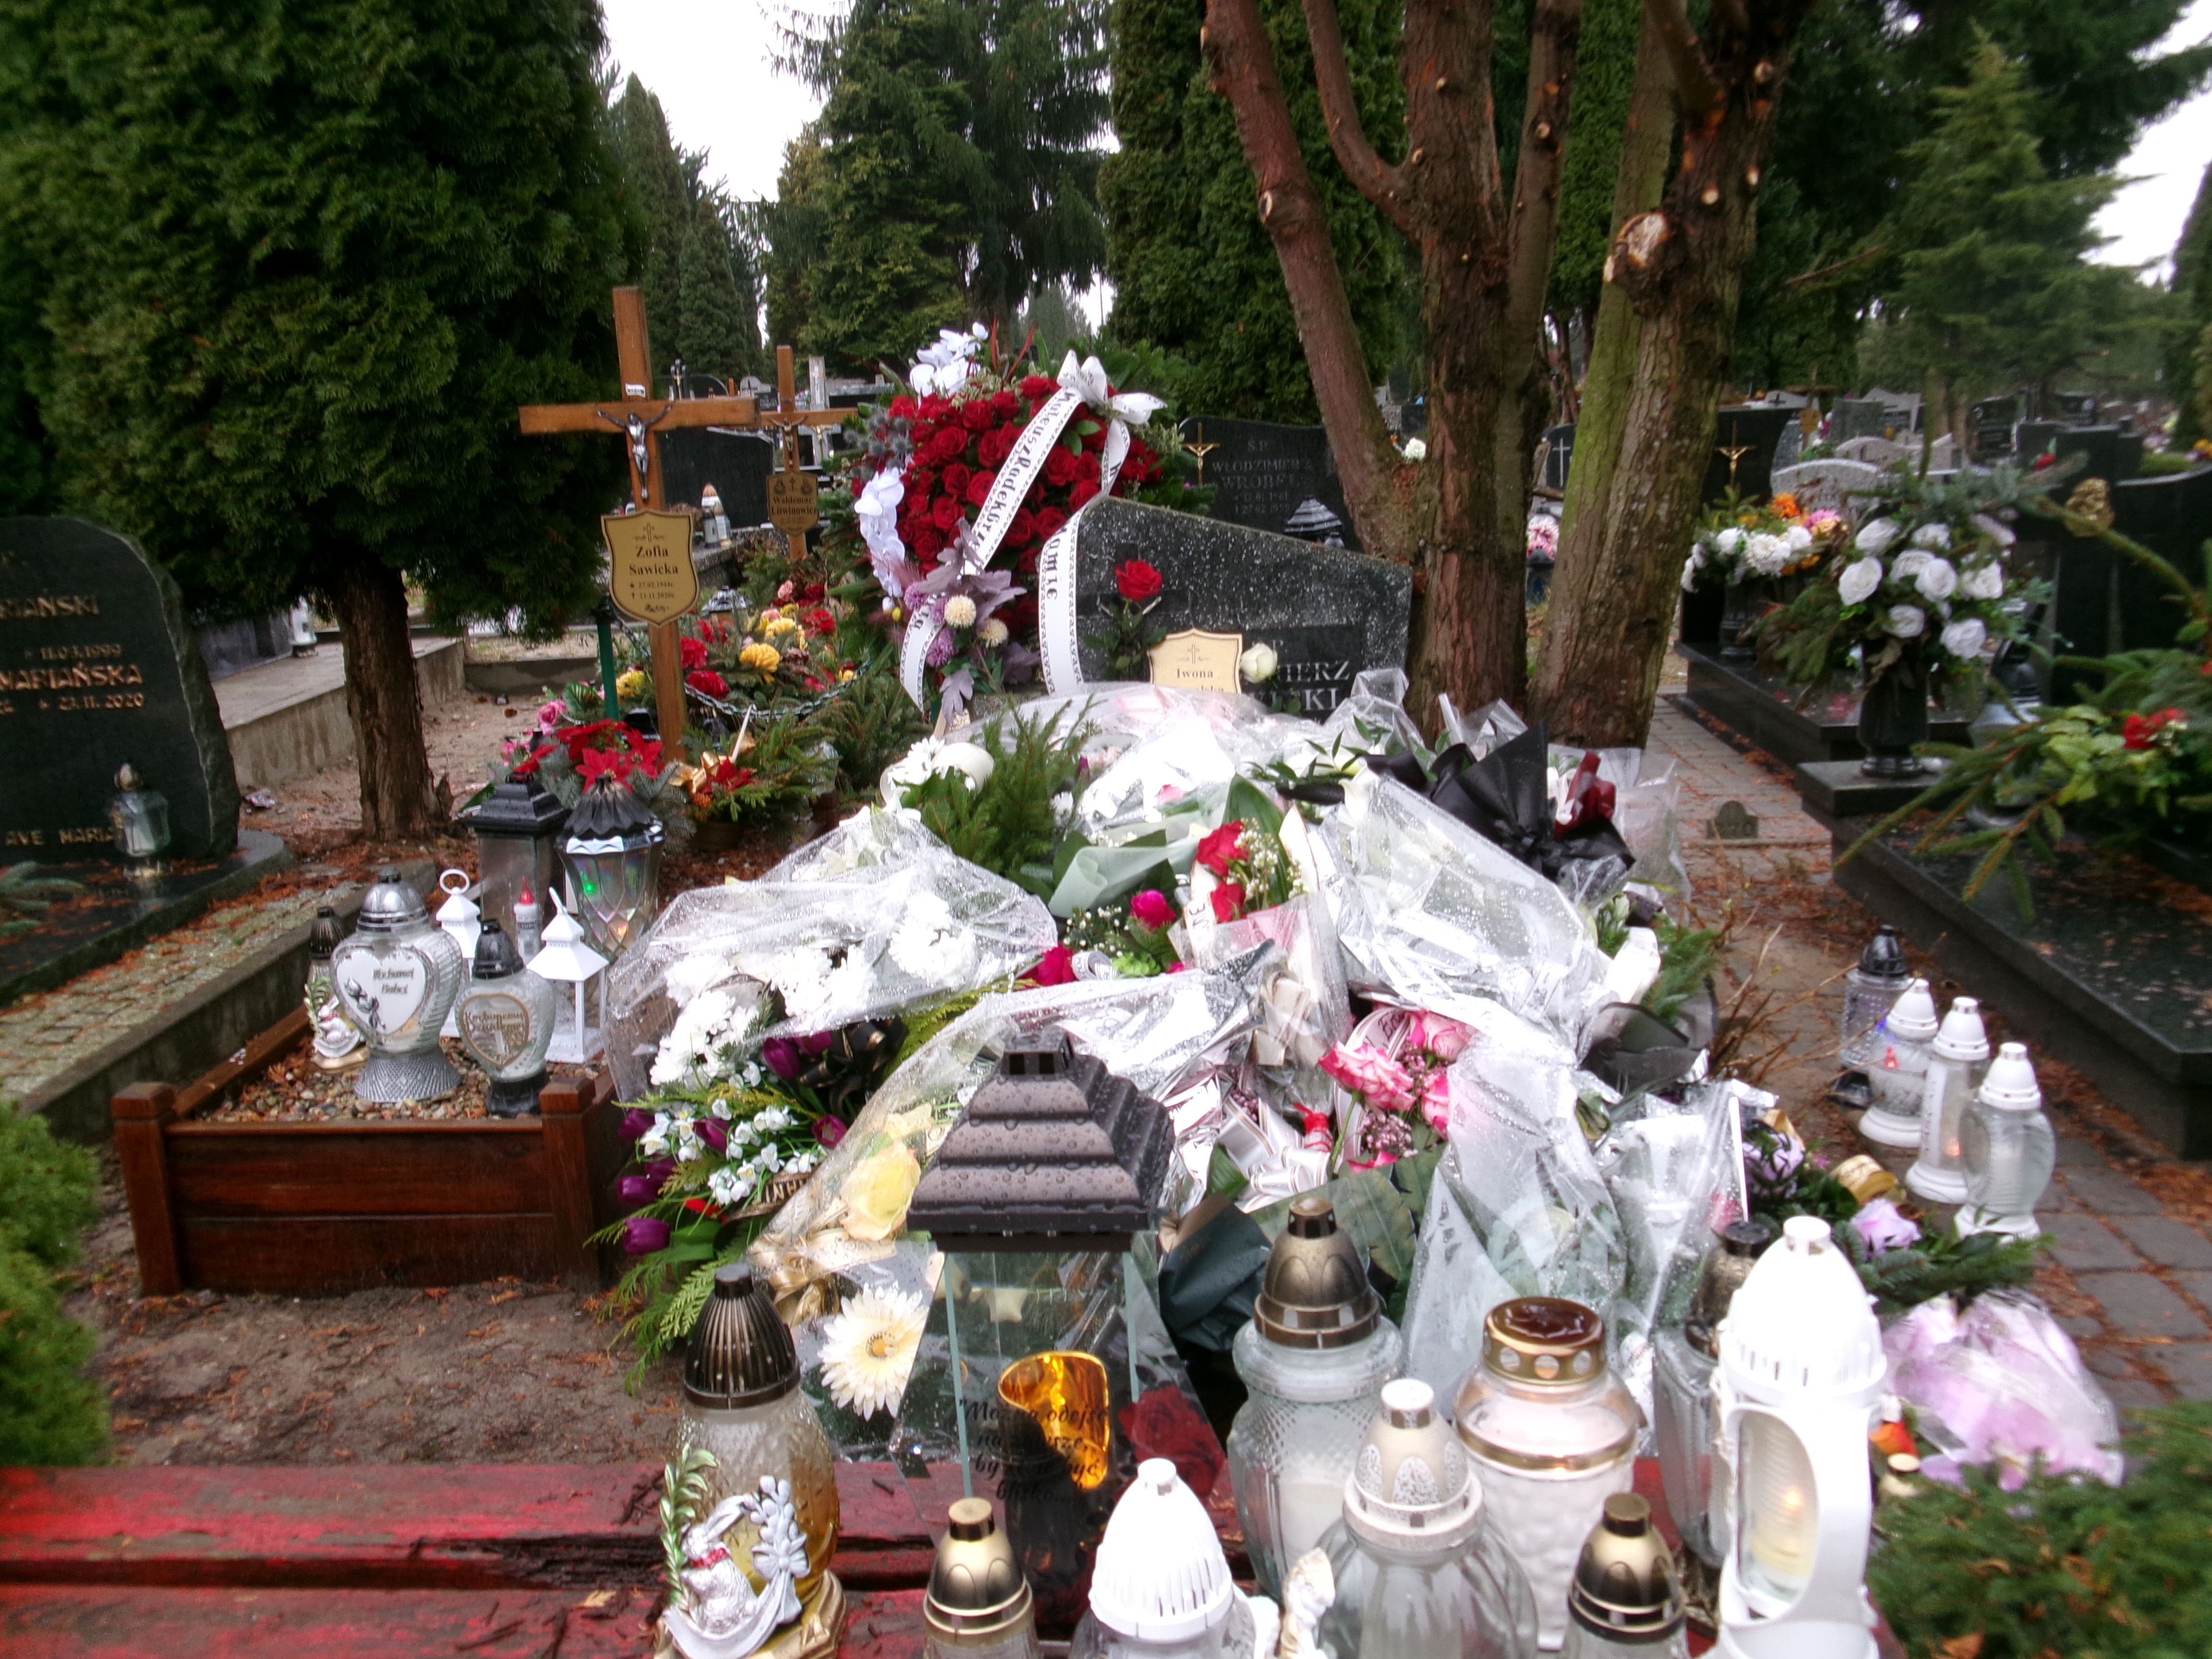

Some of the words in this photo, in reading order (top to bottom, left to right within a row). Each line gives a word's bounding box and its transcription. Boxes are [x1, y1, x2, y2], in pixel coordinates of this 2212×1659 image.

[773, 496, 811, 505] Waldemar
[636, 545, 669, 557] Zofia
[629, 563, 679, 575] Sawicka
[1176, 669, 1214, 679] Iwona
